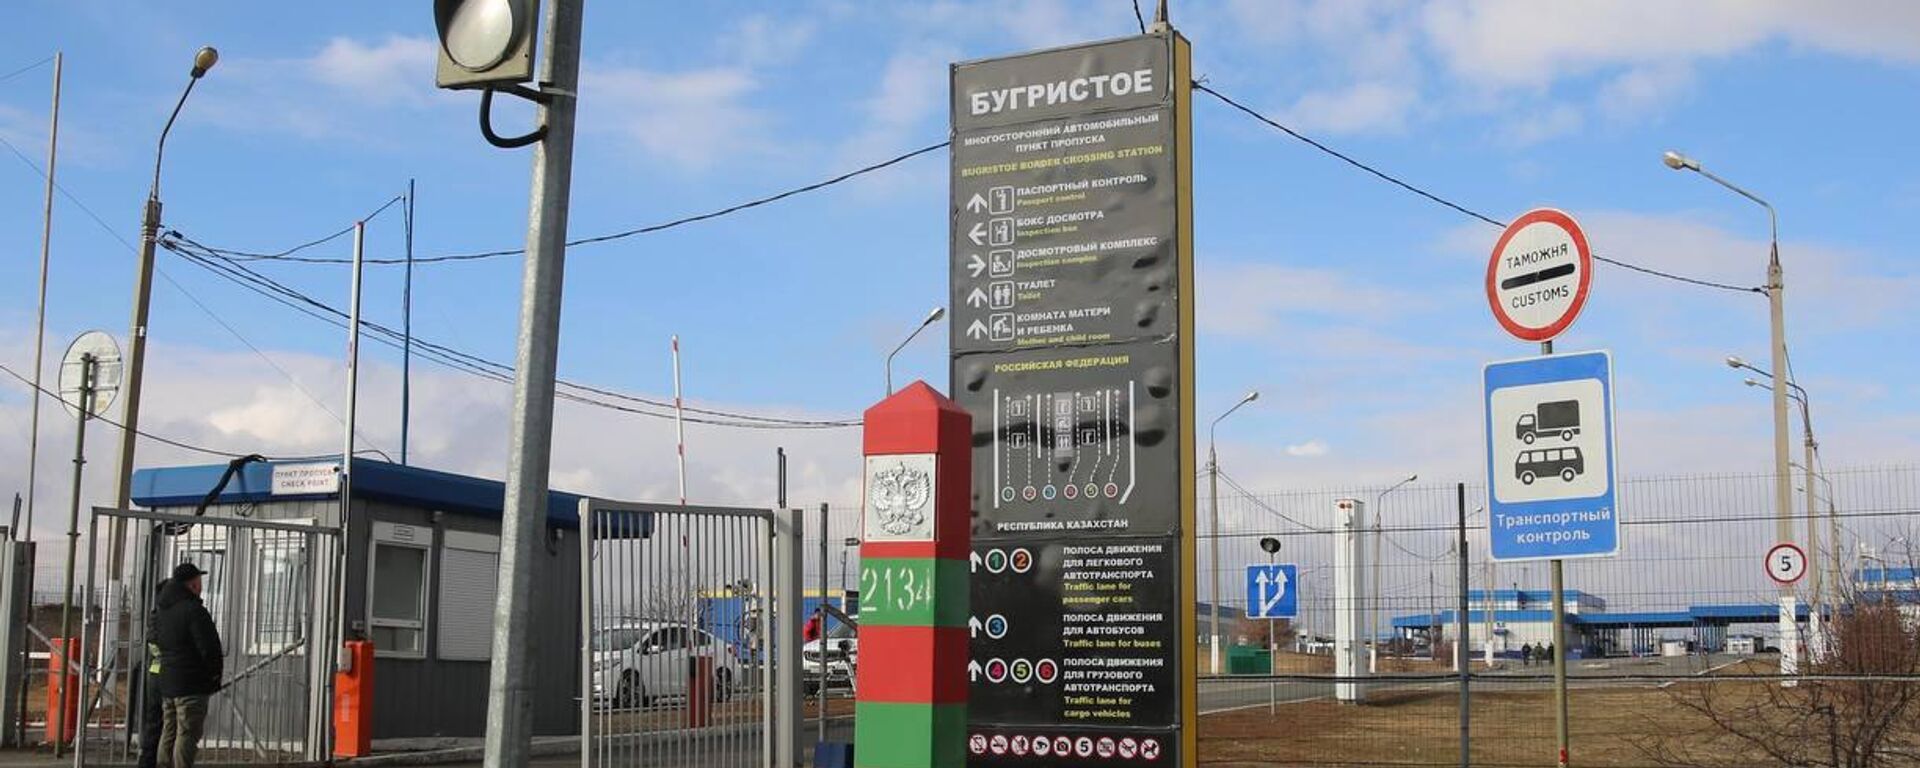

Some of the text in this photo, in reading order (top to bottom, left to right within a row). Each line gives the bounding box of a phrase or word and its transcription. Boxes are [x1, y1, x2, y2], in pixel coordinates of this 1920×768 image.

[971, 69, 1153, 115] БУГРИСТОЕ
[965, 113, 1159, 146] МНОГОСТОРОННИЙ АВТОМОБИЛЬНЫЙ
[1015, 134, 1106, 153] ПУНКТ ПРОПУСКА
[962, 145, 1163, 178] BUGRISTOE BORDER CROSSING STATION
[1016, 174, 1148, 196] ПАСПОРТНЫЙ КОНТРОЛЬ
[1016, 210, 1105, 227] БОКС ДОСМОТРА
[1016, 236, 1158, 260] ДОСМОТРОВЫЙ КОМПЛЕКС
[1505, 243, 1568, 269] ТАМОЖНЯ
[1016, 279, 1056, 291] ТУАЛЕТ
[1017, 291, 1041, 300] Toilet
[1511, 285, 1570, 309] CUSTOMS
[1016, 306, 1111, 323] КОМНАТА МАТЕРИ
[1016, 323, 1074, 336] И РЕБЕНКА
[1088, 333, 1111, 341] room
[994, 355, 1130, 373] РОССИЙСКАЯ ФЕДЕРАЦИЯ
[997, 519, 1129, 531] РЕСПУБЛИКА КАЗАХСТАН
[1495, 507, 1611, 530] Транспортный
[1516, 528, 1591, 545] контроль
[1063, 545, 1162, 555] ПОЛОСА ДВИЖЕНИЯ
[992, 554, 1027, 568] 1 2
[1063, 557, 1143, 568] ДЛЯ ЛЕГКОВОГО
[1780, 556, 1792, 571] 5
[1063, 570, 1154, 580] АВТОТРАНСПОРТА
[861, 567, 932, 612] 2134
[1064, 582, 1132, 591] Traffic lane for
[1062, 596, 1110, 605] passenger
[1063, 613, 1163, 623] ПОЛОСА ДВИЖЕНИЯ
[991, 619, 1002, 633] 3
[1063, 626, 1145, 636] ДЛЯ АВТОБУСОВ
[1064, 639, 1162, 648] Traffic lane for buses
[1063, 658, 1164, 668] ПОЛОСА ДВИЖЕНИЯ
[991, 663, 1052, 678] 4 5 6
[1063, 670, 1143, 680] ДЛЯ ГРУЗОВОГО
[1063, 683, 1155, 693] АВТОТРАНСПОРТА
[1064, 696, 1132, 705] Traffic lane for
[1063, 708, 1131, 719] cargo vehicles
[1079, 737, 1090, 754] 5
